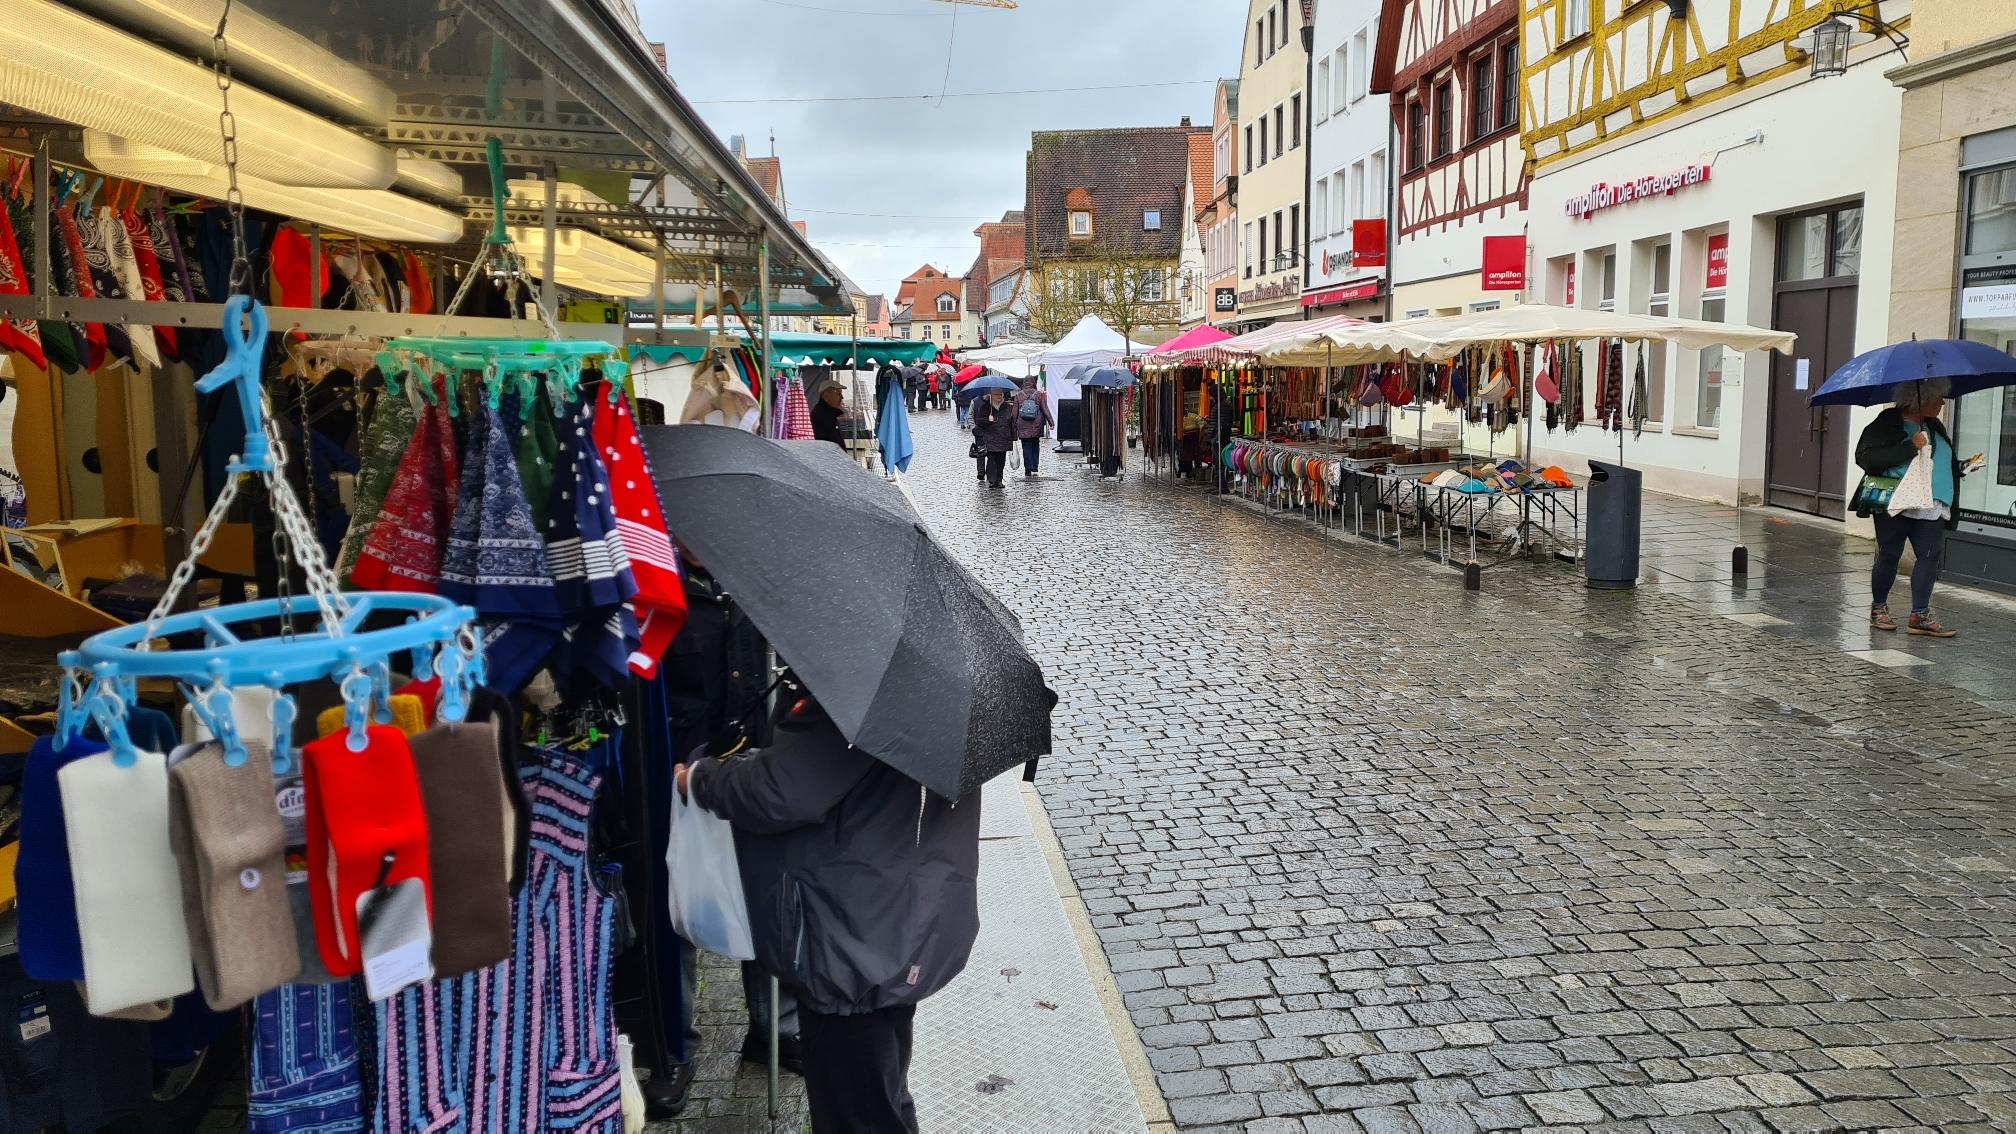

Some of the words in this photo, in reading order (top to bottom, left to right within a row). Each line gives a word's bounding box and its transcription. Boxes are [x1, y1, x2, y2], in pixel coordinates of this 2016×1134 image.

[1565, 183, 1615, 221] amplifon
[1618, 185, 1633, 203] Die
[1635, 167, 1704, 196] Hörexperten
[1488, 270, 1522, 280] amplifon
